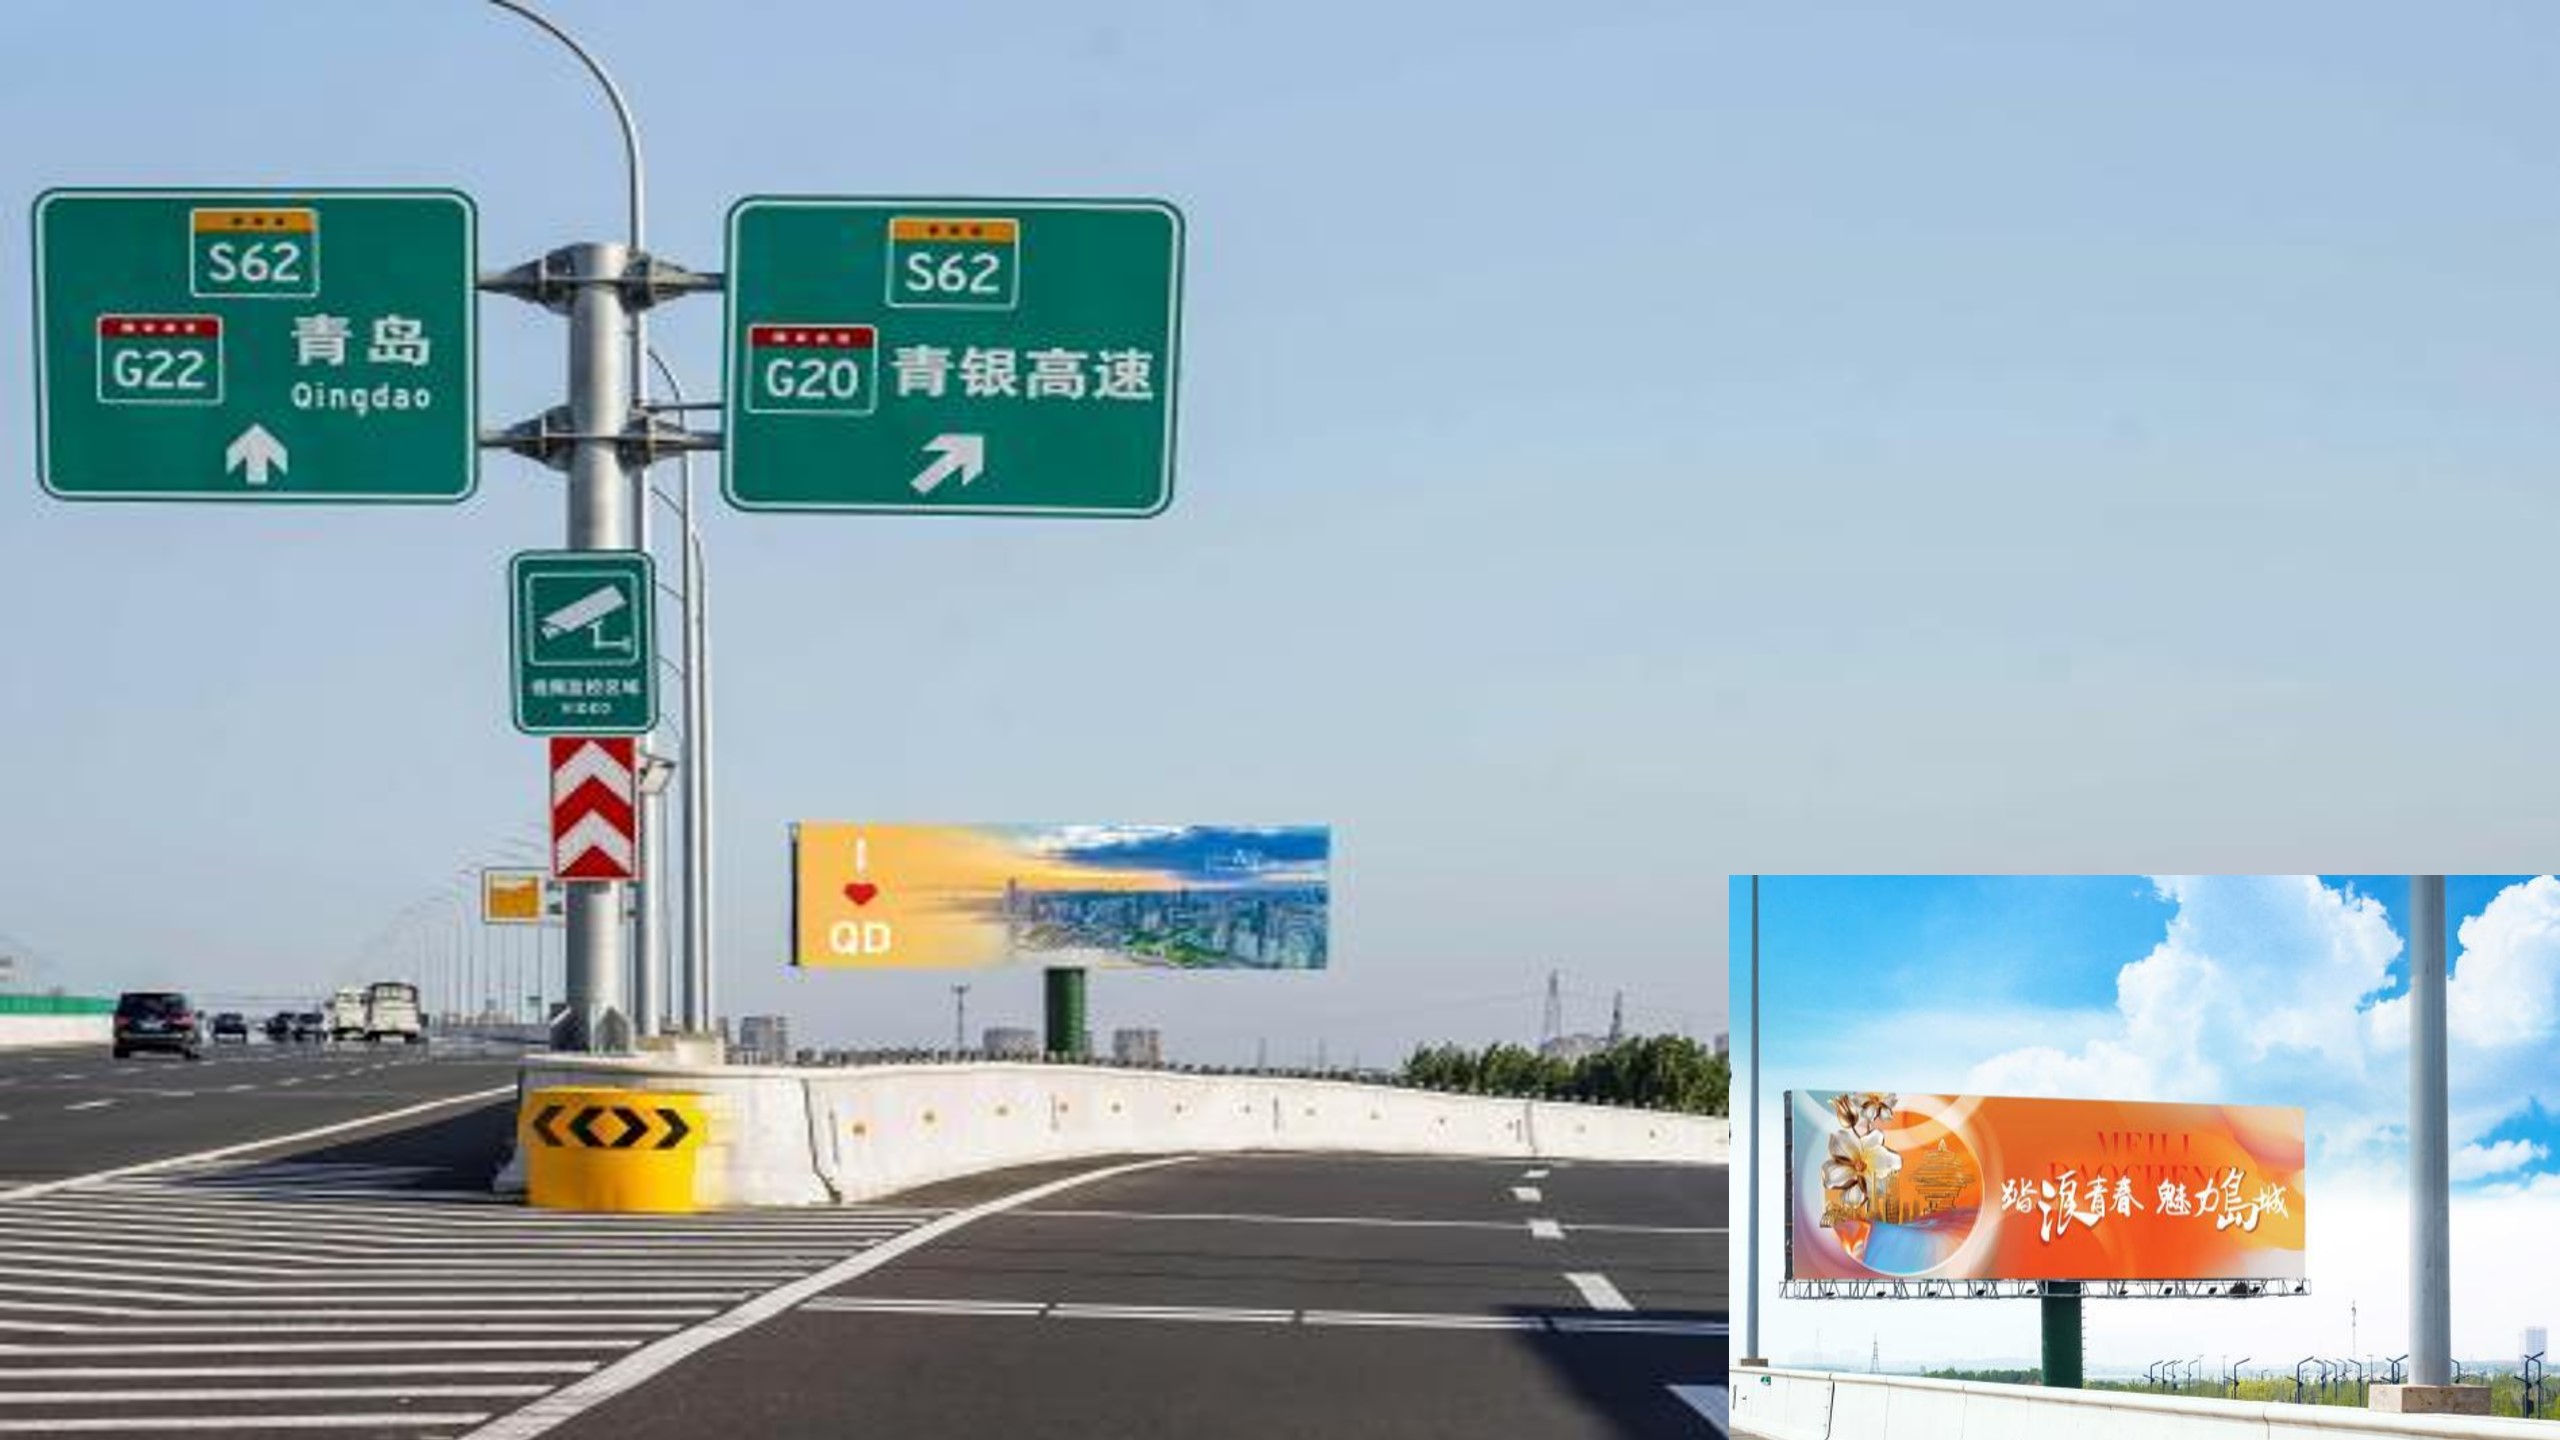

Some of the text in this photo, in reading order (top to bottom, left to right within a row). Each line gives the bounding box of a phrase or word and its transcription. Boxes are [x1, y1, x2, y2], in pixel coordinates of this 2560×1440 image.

[209, 242, 300, 281] S62
[906, 252, 1000, 294] S62
[291, 313, 430, 366] 青岛
[114, 349, 206, 388] G22
[766, 358, 858, 398] G20
[891, 344, 1153, 400] 青银高速
[292, 382, 430, 416] Qingdao
[855, 838, 867, 874] I
[830, 920, 891, 955] QD
